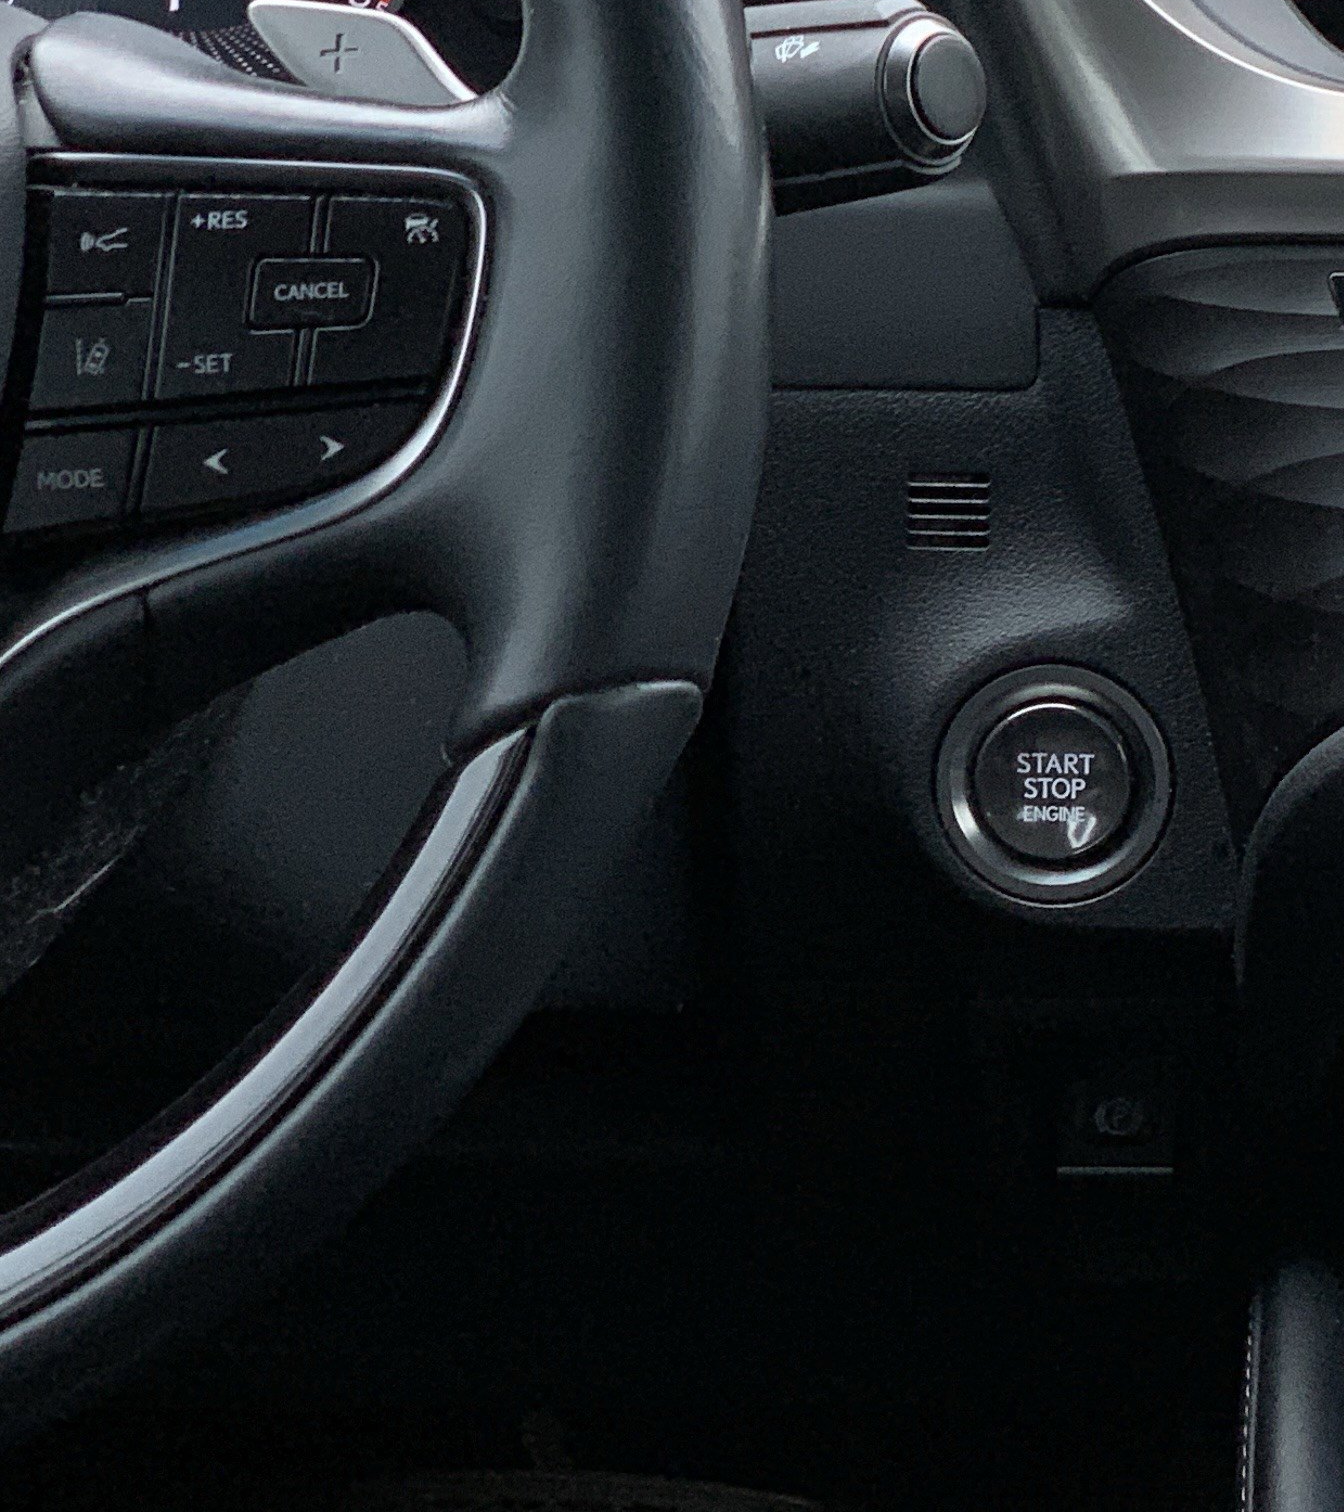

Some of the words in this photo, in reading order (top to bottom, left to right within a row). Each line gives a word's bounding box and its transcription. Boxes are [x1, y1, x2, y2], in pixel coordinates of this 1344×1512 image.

[274, 280, 349, 301] CANCEL
[36, 469, 105, 489] MODE
[1016, 753, 1095, 775] START
[1023, 778, 1086, 799] STOP
[1022, 805, 1085, 822] ENGINE
